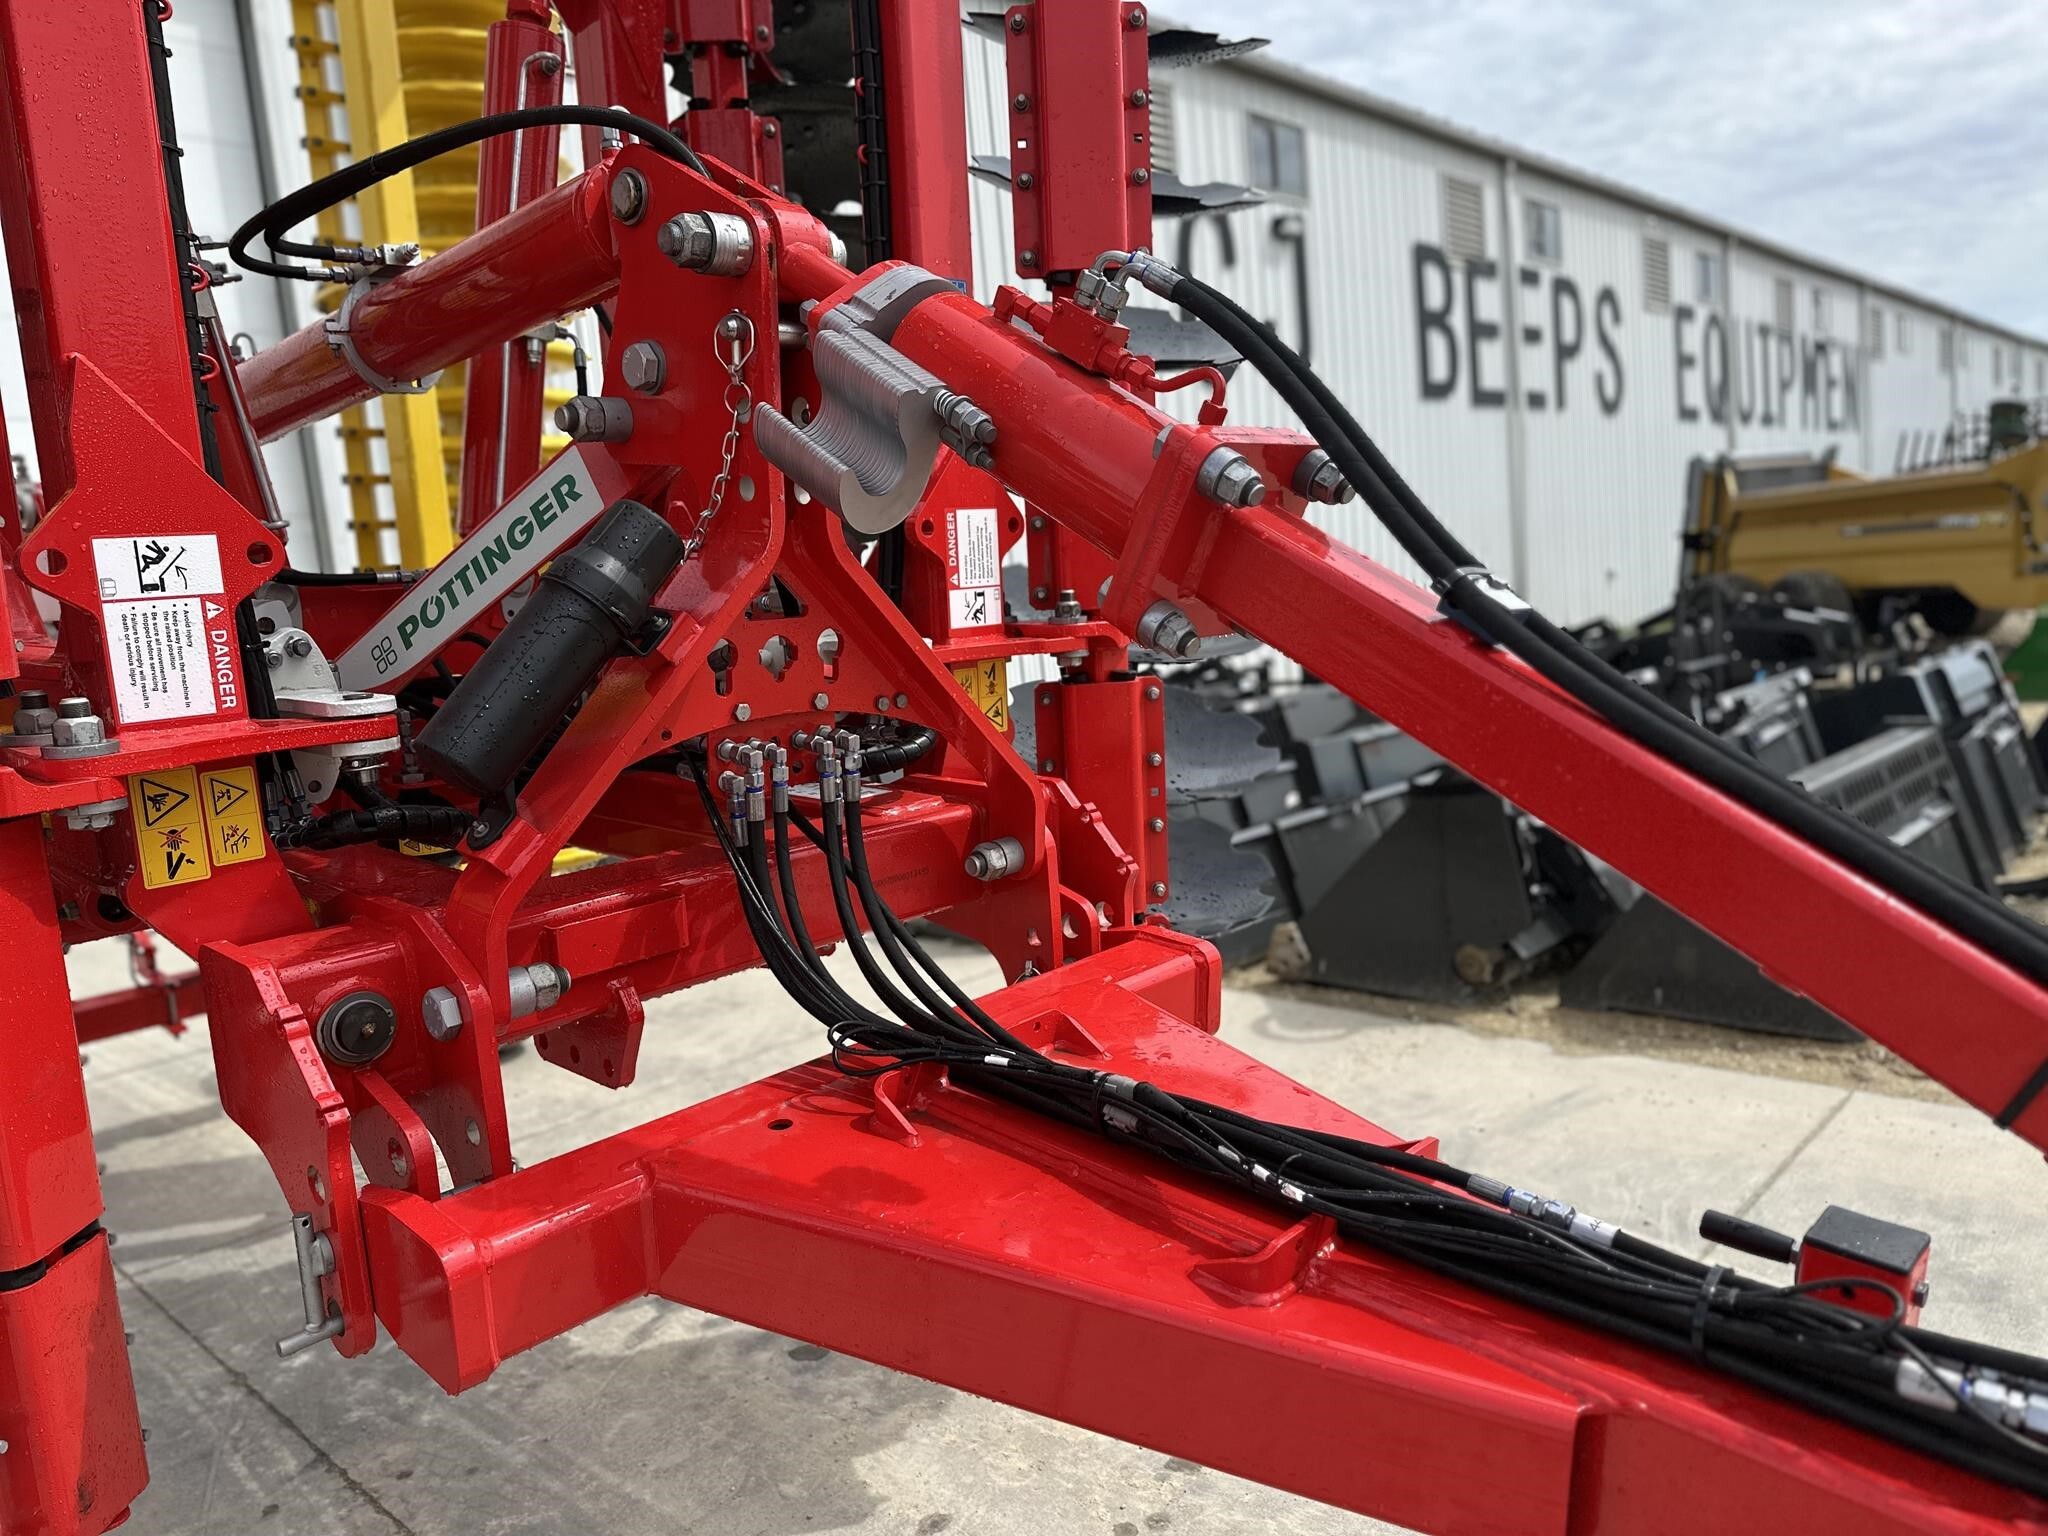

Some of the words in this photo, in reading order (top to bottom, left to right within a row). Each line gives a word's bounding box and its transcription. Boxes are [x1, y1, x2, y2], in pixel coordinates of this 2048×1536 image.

[1414, 243, 1625, 416] BEEPS
[946, 512, 957, 566] DANGER
[396, 473, 584, 651] PÖTTINGER
[121, 613, 130, 633] death
[129, 613, 139, 636] Failure
[141, 612, 153, 639] stopped
[150, 611, 158, 621] Be
[162, 610, 170, 622] the
[171, 610, 179, 628] Keep
[182, 609, 192, 629] Avoid
[124, 633, 131, 641] or
[152, 622, 160, 637] sure
[164, 622, 174, 643] raised
[173, 628, 182, 645] away
[184, 629, 194, 648] injury
[133, 636, 140, 644] to
[146, 639, 155, 661] before
[154, 637, 162, 646] all
[125, 642, 135, 667] serious
[134, 644, 144, 669] comply
[156, 646, 167, 681] movement
[166, 643, 177, 671] position
[176, 645, 184, 662] from
[128, 667, 137, 687] injury
[138, 669, 147, 682] will
[149, 661, 160, 692] servicing
[178, 661, 186, 673] the
[210, 629, 237, 709] DANGER
[140, 682, 150, 702] result
[161, 681, 169, 694] has
[180, 673, 190, 701] machine
[143, 701, 151, 709] in
[184, 701, 192, 709] in
